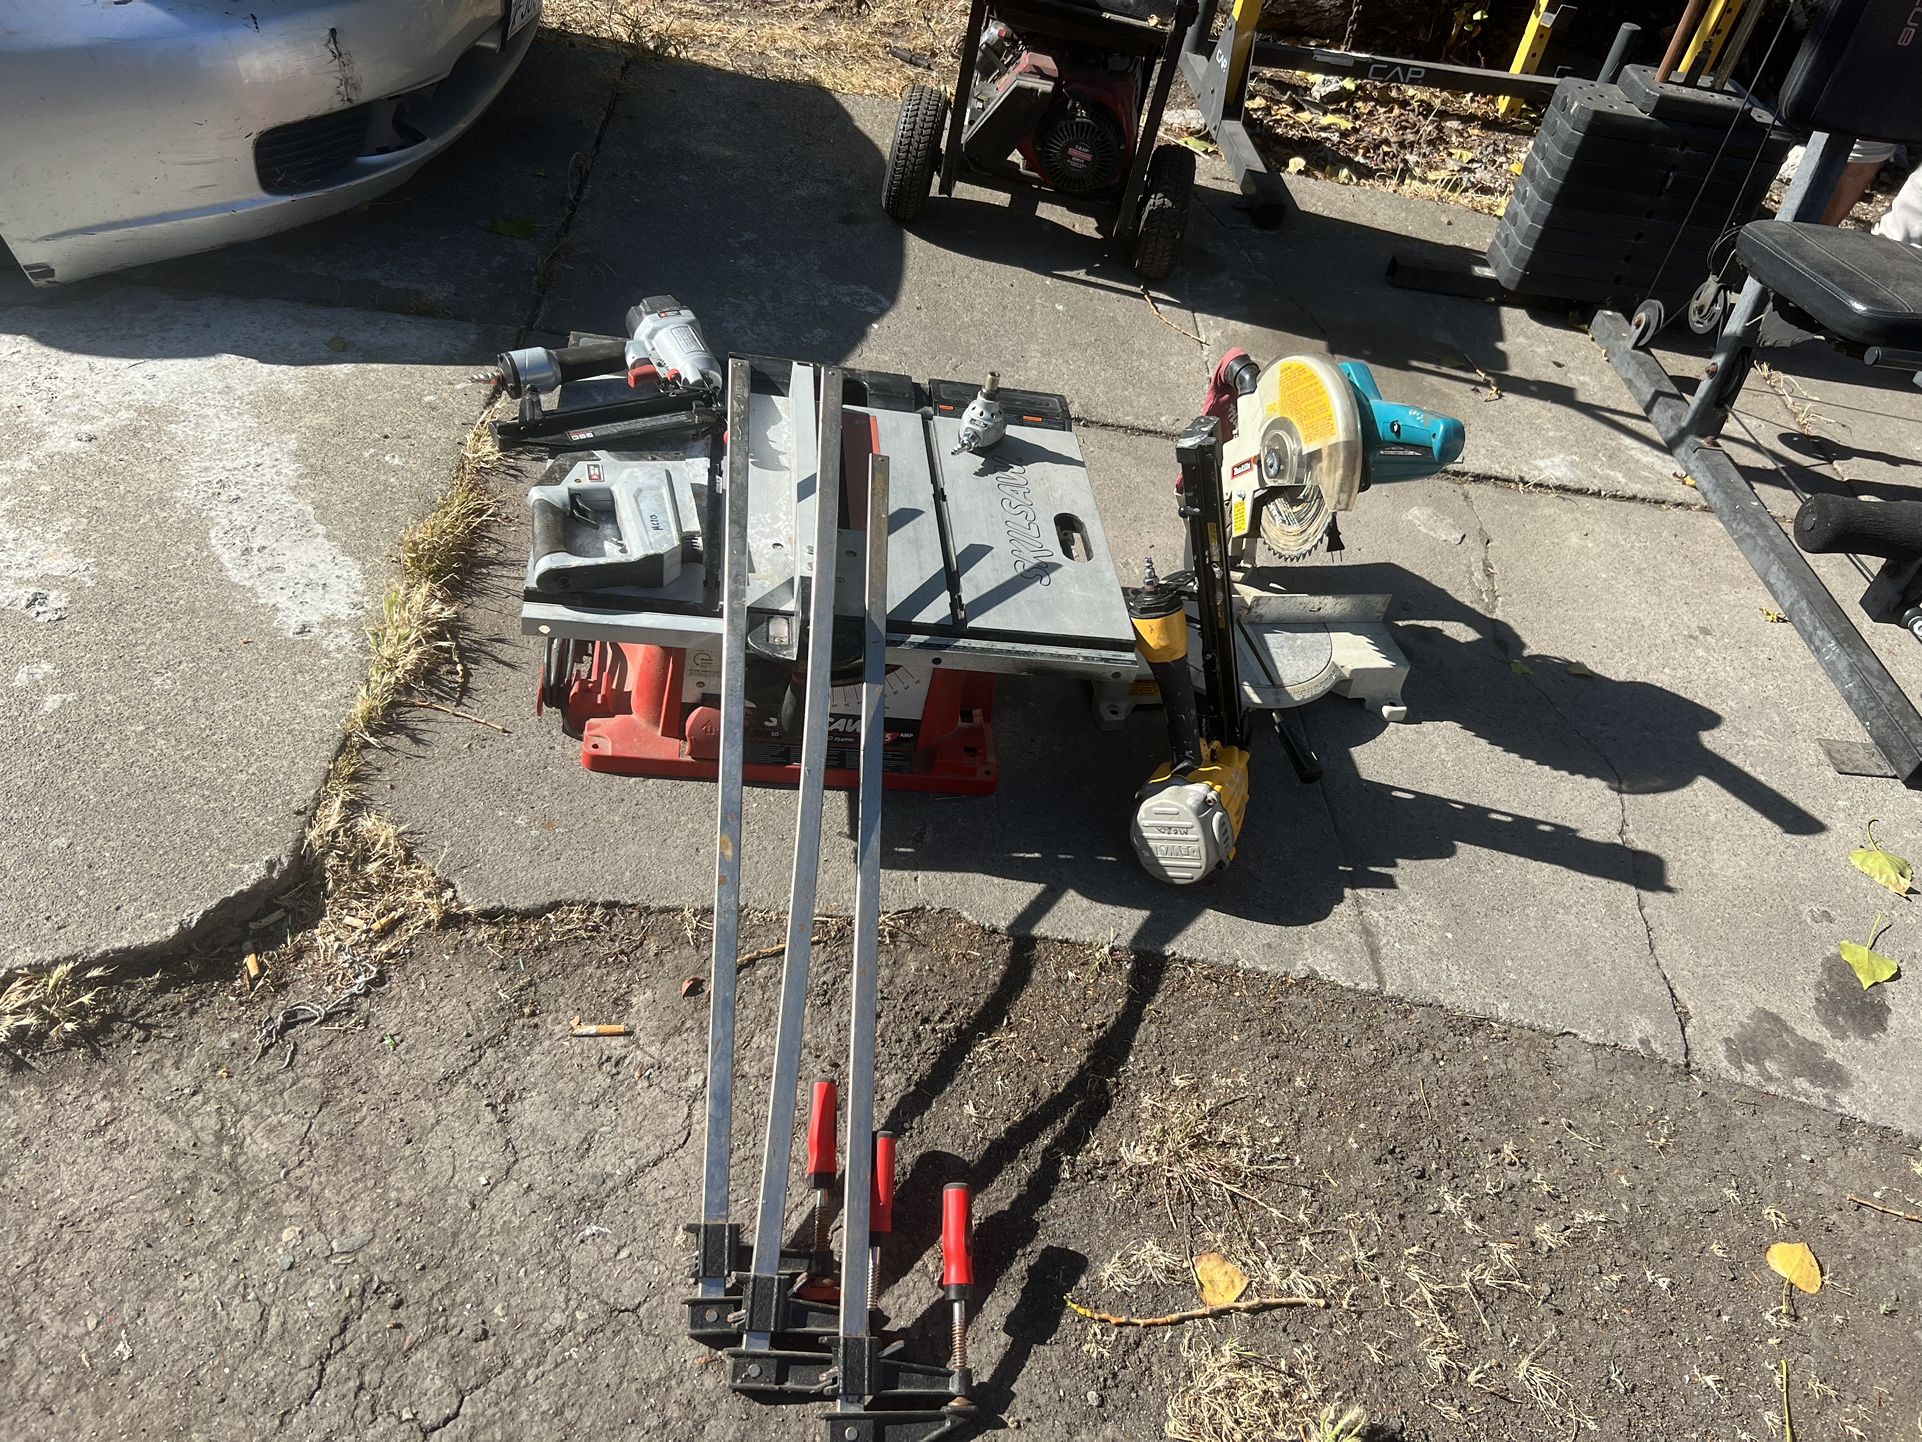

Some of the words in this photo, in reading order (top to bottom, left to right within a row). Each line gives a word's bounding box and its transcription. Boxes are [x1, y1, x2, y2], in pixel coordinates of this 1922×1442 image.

[1368, 64, 1425, 83] CAP
[992, 455, 1054, 586] SKILSAW
[1149, 845, 1200, 857] DEWA
